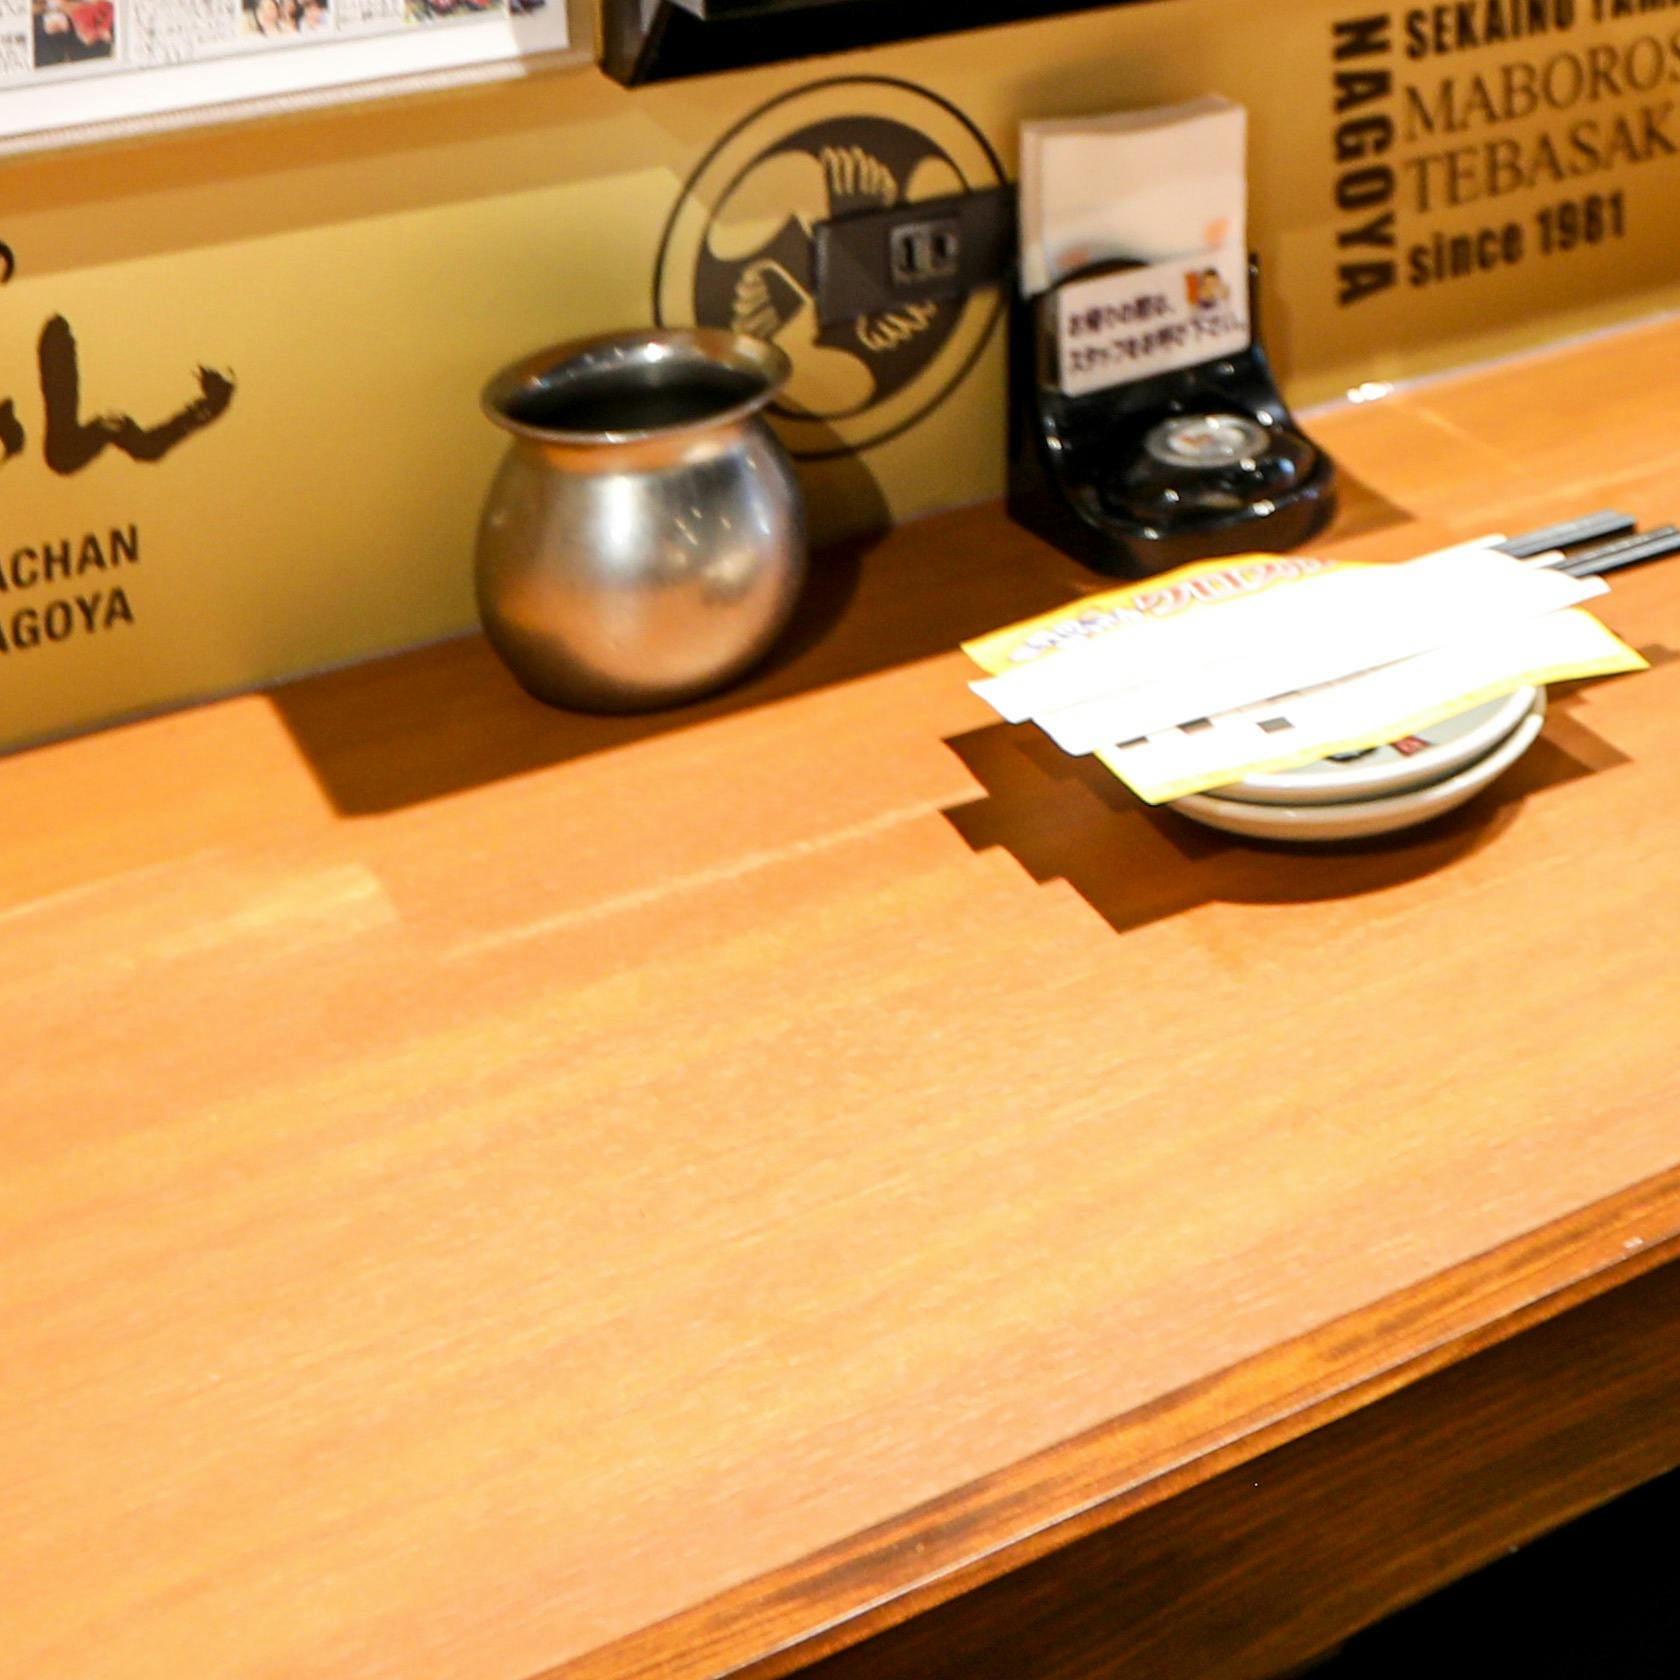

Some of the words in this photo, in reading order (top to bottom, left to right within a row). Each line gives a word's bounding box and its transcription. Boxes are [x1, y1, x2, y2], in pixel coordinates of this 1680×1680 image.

[1331, 12, 1398, 308] NAGOYA
[1408, 221, 1526, 288] since
[1534, 189, 1627, 256] 1981
